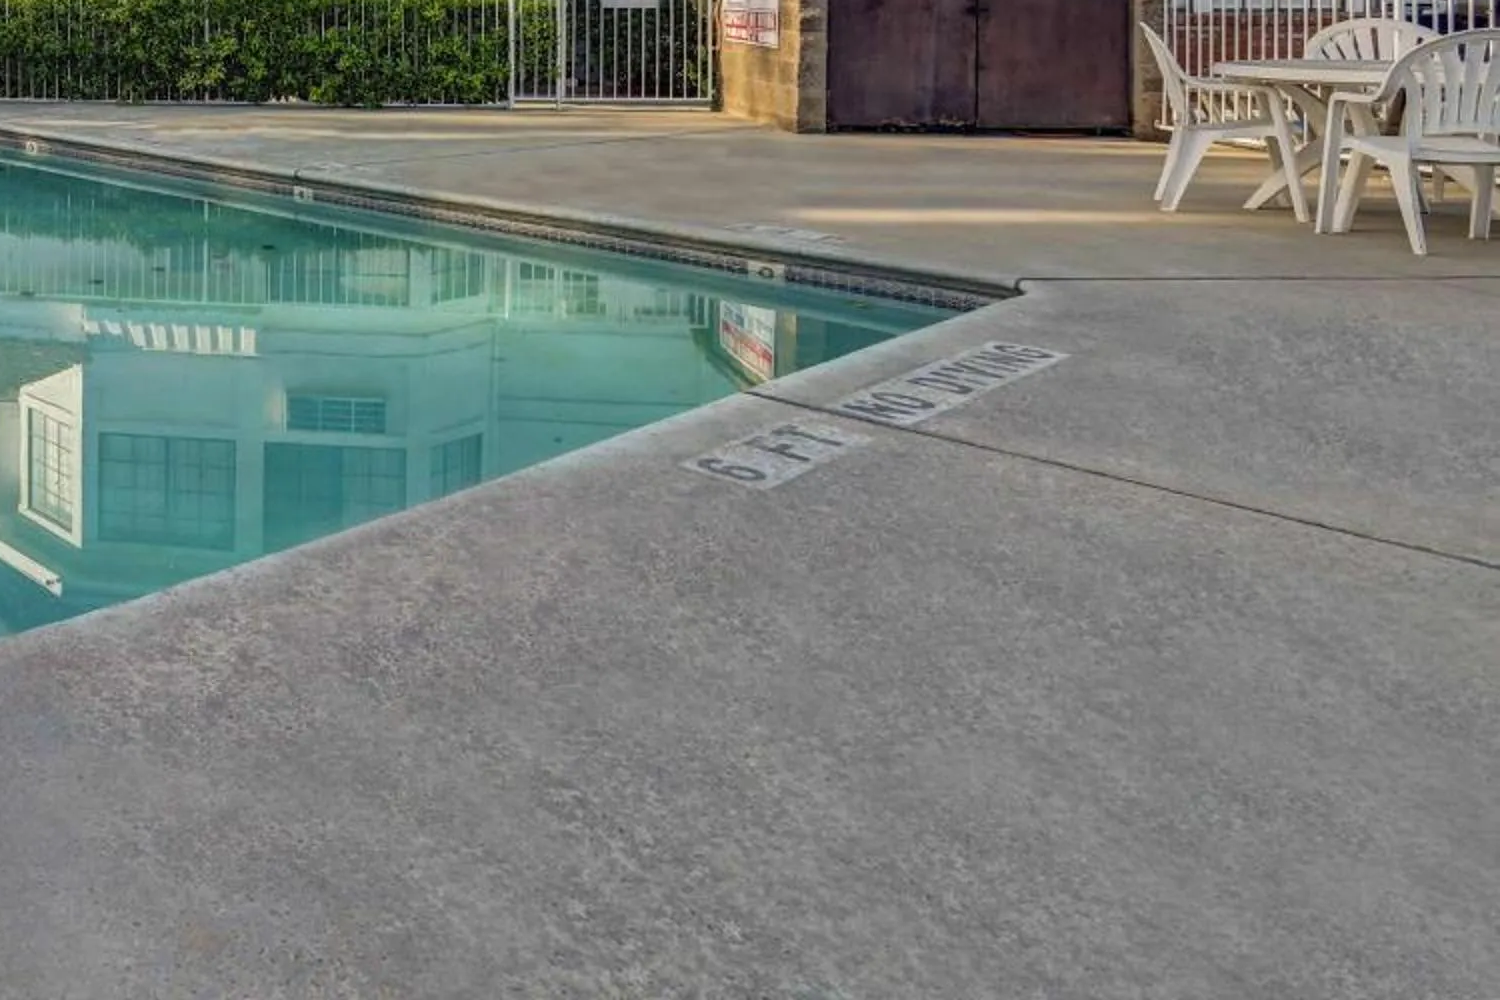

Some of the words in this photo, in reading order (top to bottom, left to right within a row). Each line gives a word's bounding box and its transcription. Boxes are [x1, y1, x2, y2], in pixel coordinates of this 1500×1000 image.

[842, 391, 937, 422] NO
[907, 342, 1058, 394] DIVING
[697, 457, 767, 482] 6
[743, 424, 847, 463] FT
